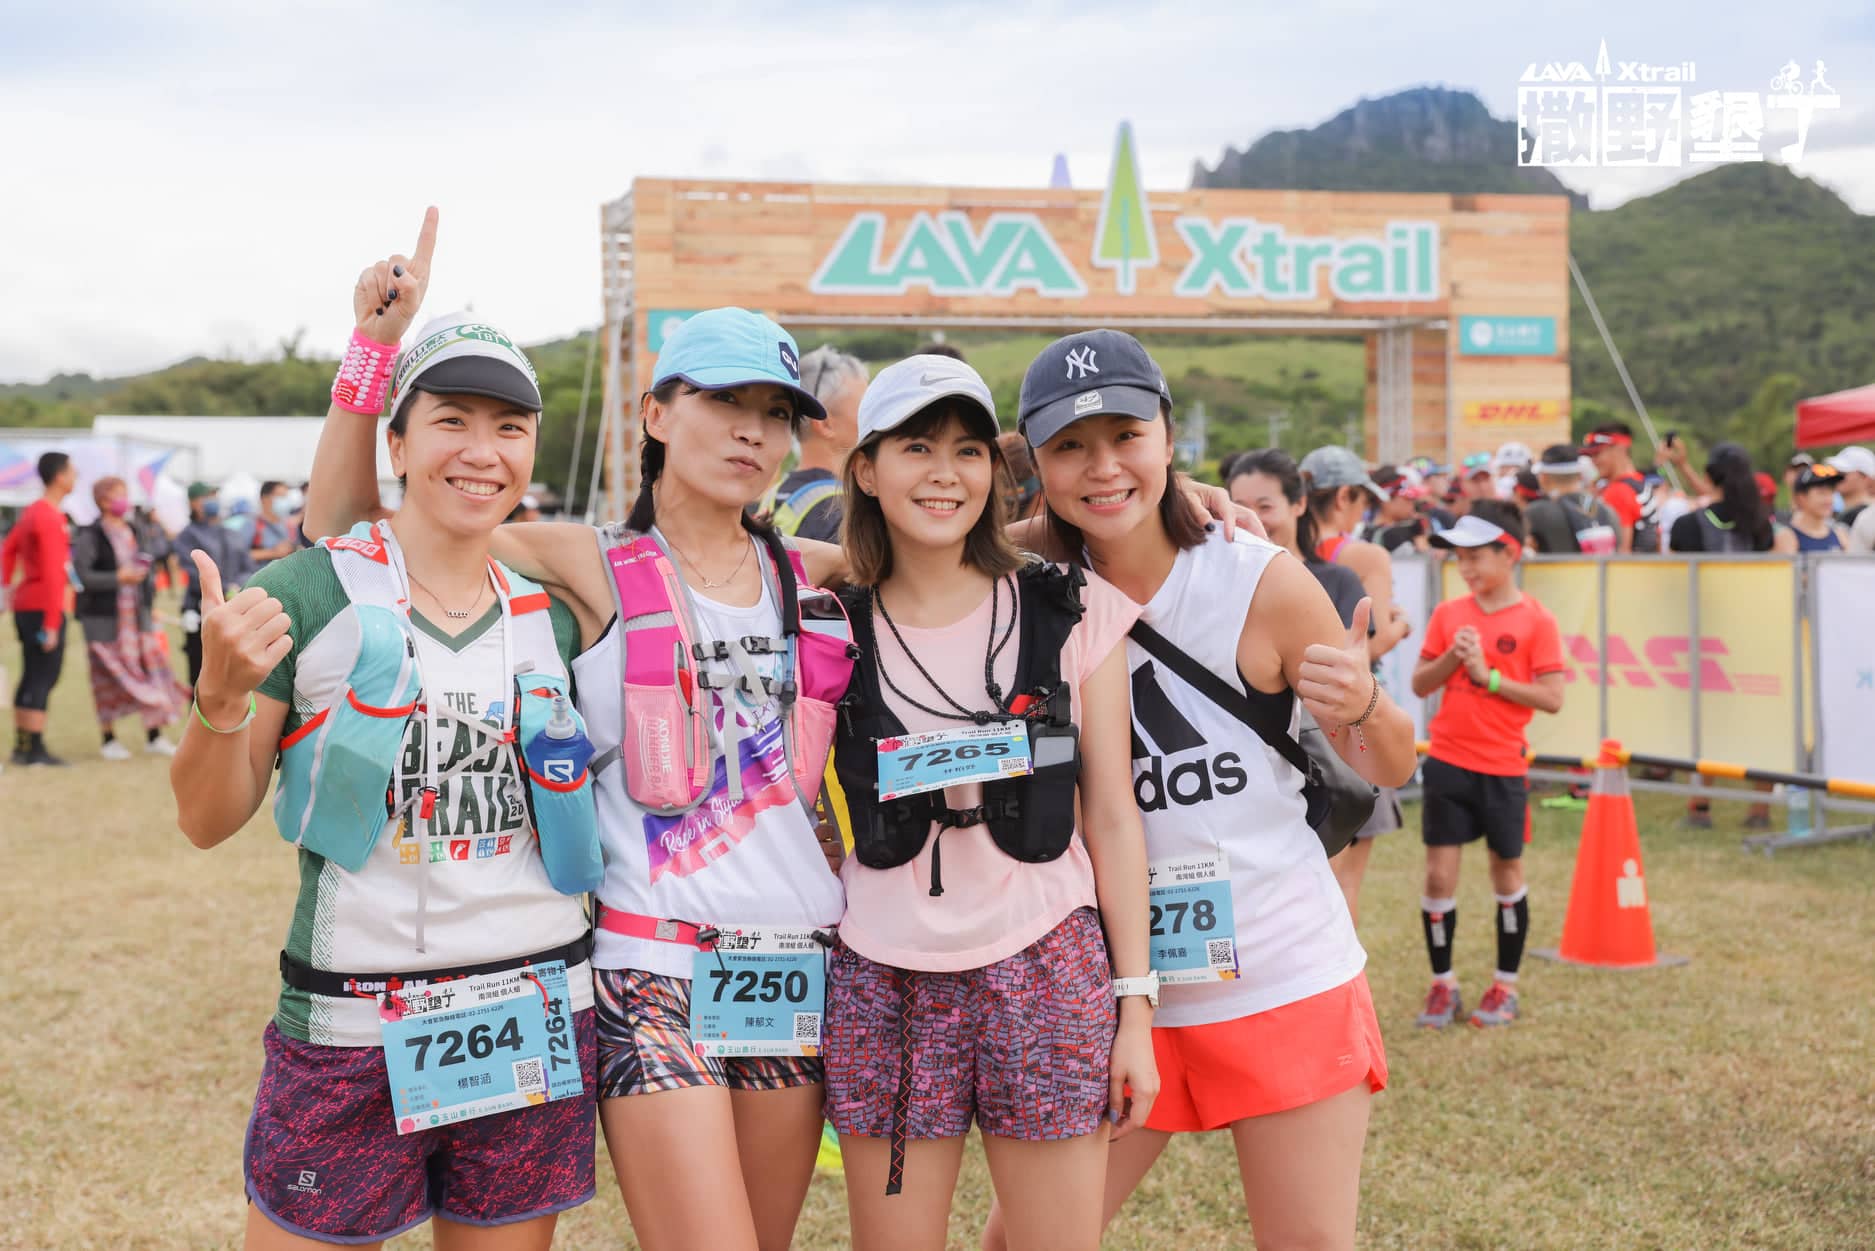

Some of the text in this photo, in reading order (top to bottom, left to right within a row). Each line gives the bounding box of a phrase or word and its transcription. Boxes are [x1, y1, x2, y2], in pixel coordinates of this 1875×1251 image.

[810, 212, 1440, 301] LAVA Xtrail
[1065, 345, 1100, 380] NY
[444, 692, 479, 715] THE
[401, 718, 515, 775] BEAS
[898, 742, 1010, 771] 7265
[1133, 751, 1248, 813] das
[1149, 899, 1217, 937] 278
[469, 975, 520, 992] Trail Run 11KM
[709, 969, 809, 1003] 7250
[405, 1016, 524, 1073] 7264
[543, 997, 572, 1072] 7264
